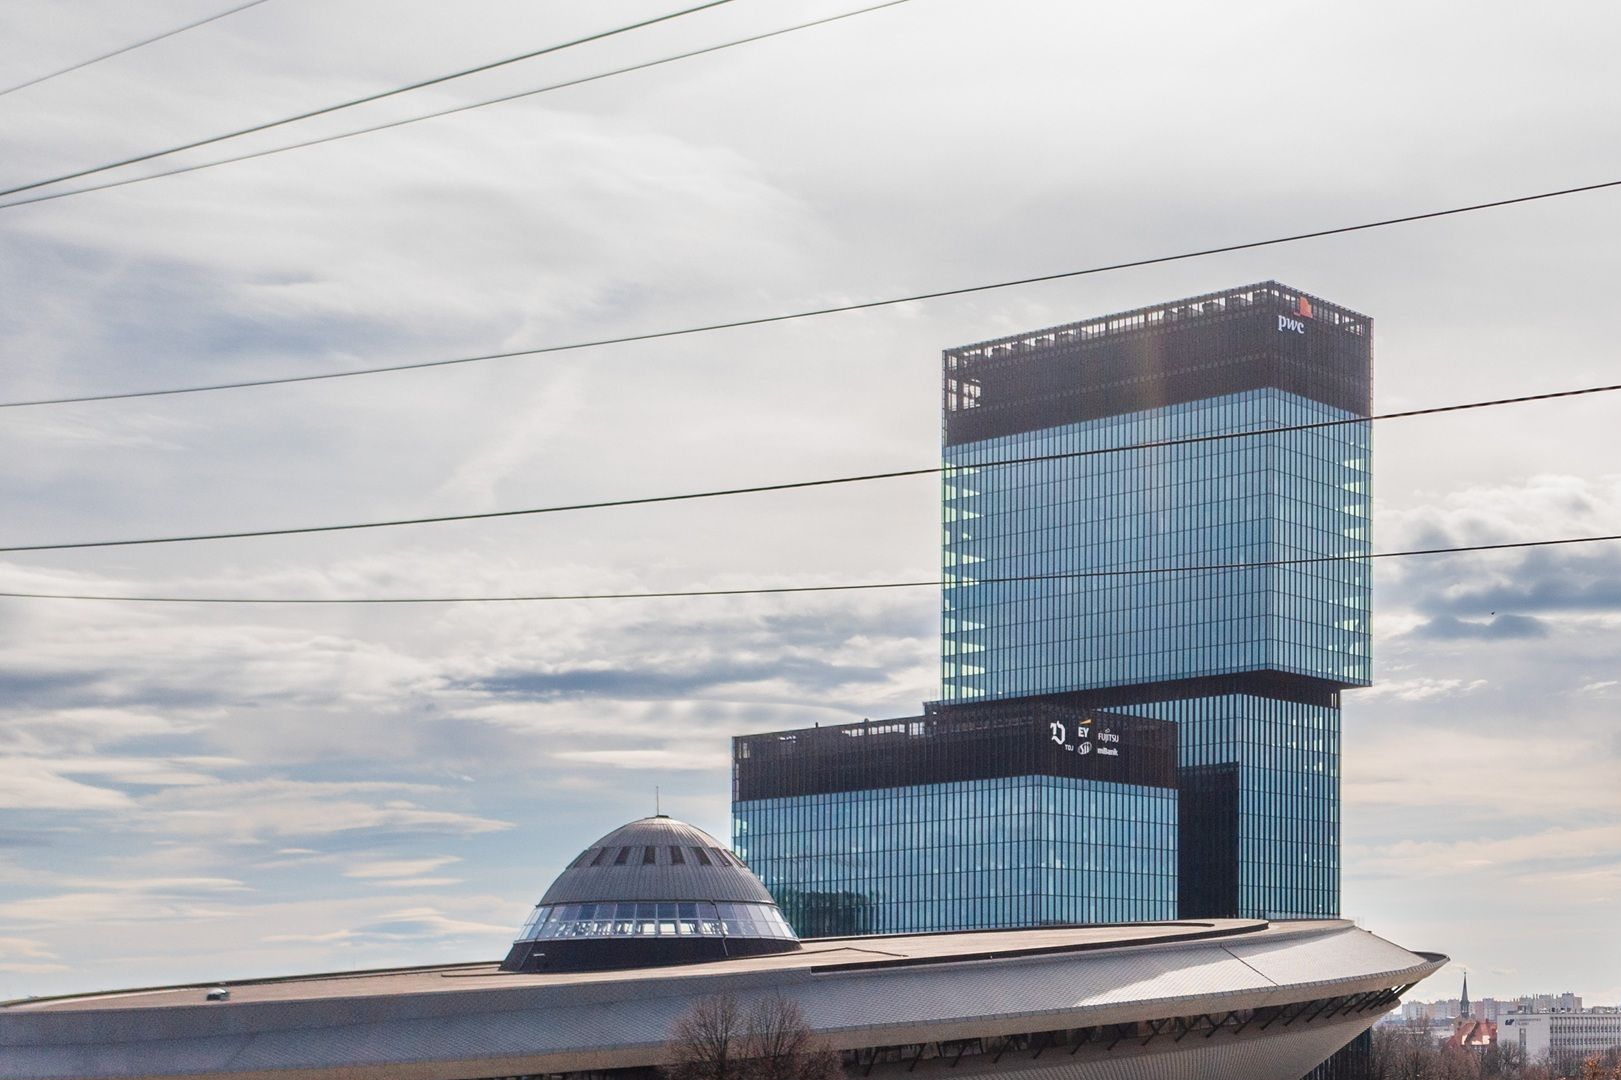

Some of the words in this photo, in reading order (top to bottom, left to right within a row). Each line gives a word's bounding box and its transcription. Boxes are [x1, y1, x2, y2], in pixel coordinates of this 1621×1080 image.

[1278, 314, 1305, 334] pwc
[1078, 726, 1089, 738] EY
[1097, 732, 1119, 743] FUJITSU
[1097, 747, 1119, 756] mBank
